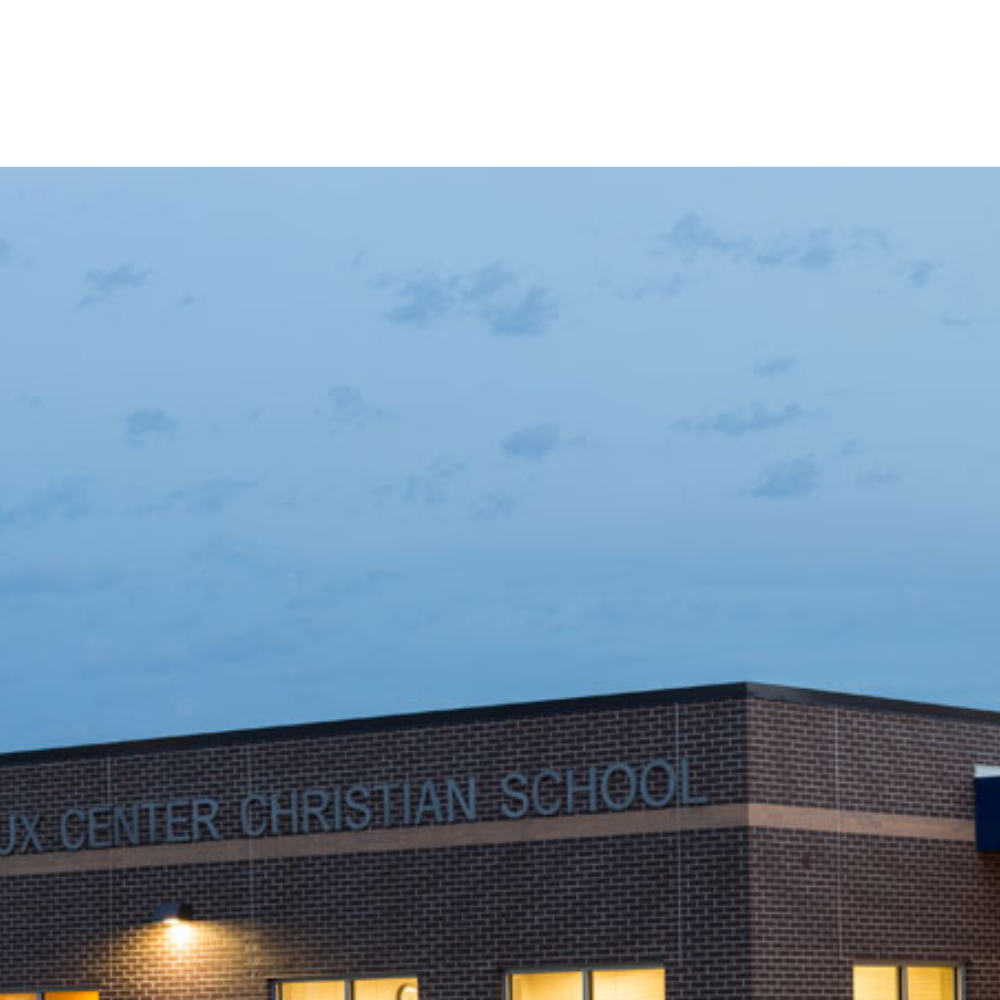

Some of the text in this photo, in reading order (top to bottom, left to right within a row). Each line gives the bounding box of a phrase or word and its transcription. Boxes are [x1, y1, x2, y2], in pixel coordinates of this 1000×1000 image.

[60, 798, 221, 850] CENTER
[240, 775, 477, 837] CHRISTIAN
[499, 757, 708, 818] SCHOOL
